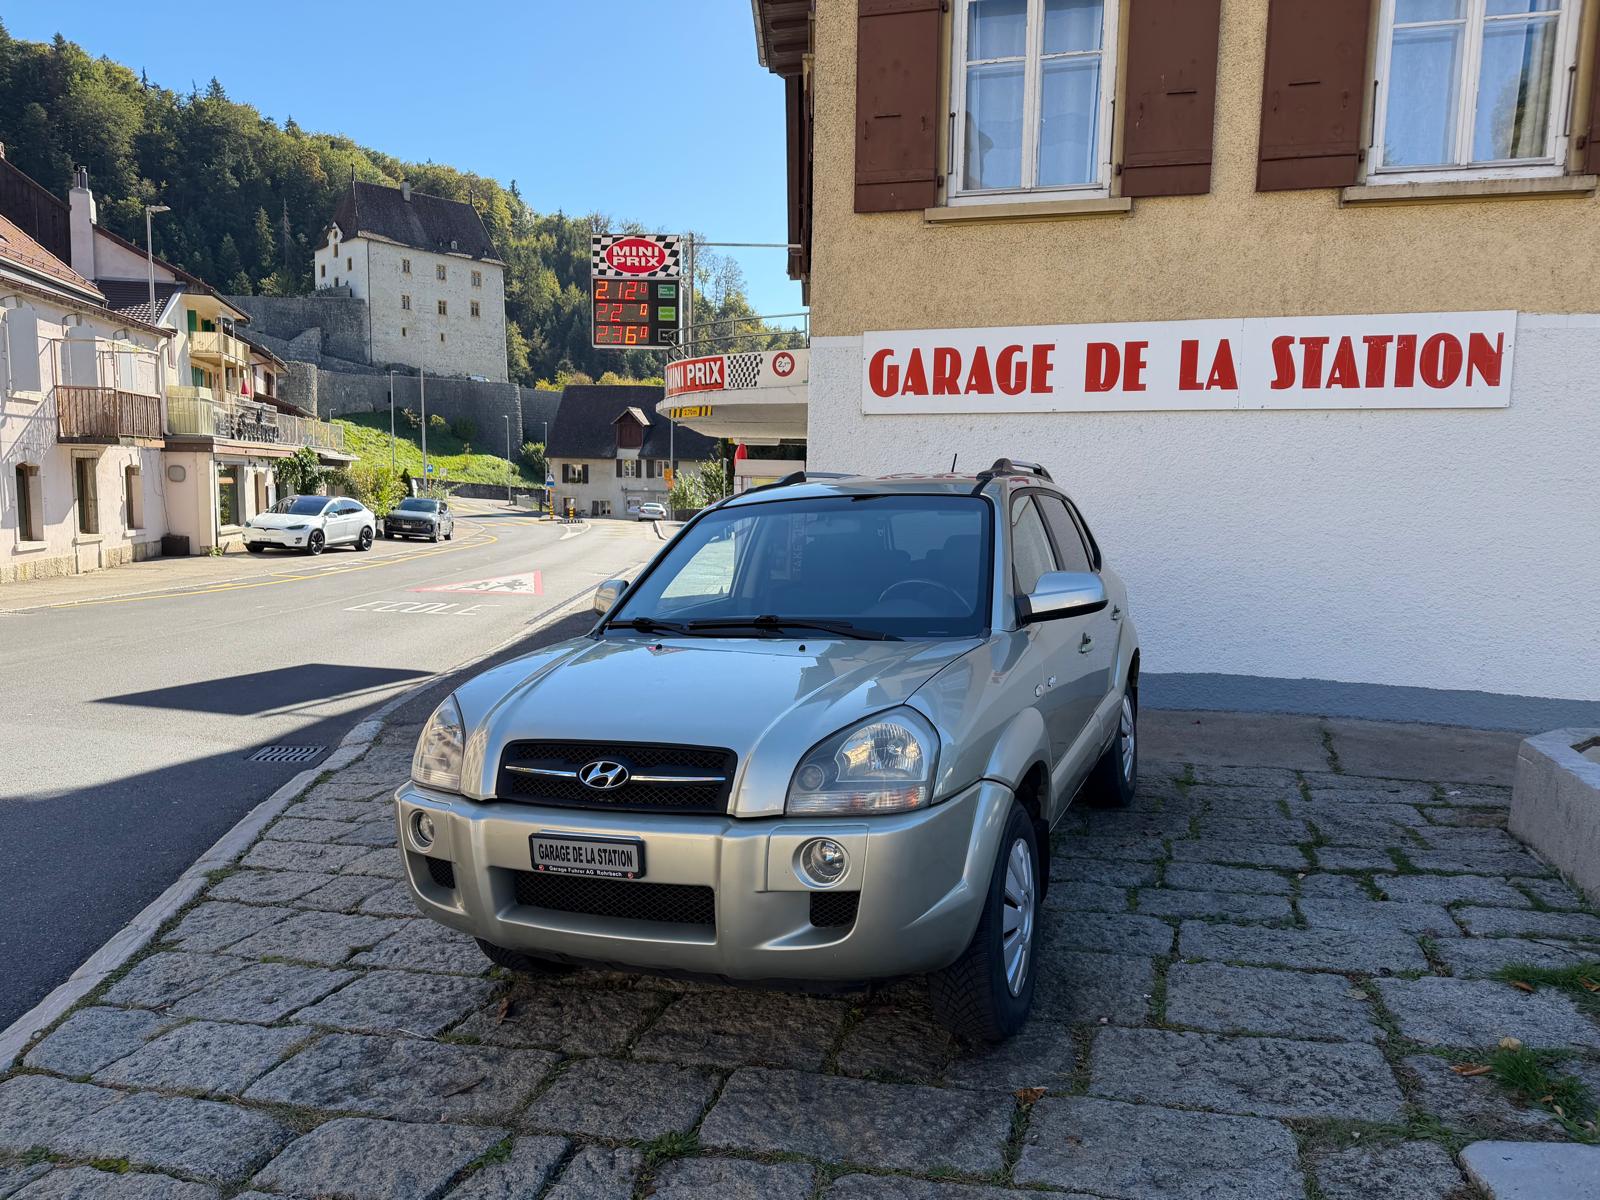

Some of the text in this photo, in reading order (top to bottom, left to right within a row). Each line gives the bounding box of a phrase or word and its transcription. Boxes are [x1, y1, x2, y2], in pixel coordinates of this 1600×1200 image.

[612, 246, 660, 257] MINI
[612, 256, 660, 267] PRIX
[686, 360, 722, 386] PRIX
[869, 332, 1504, 398] GARAGE DE LA STATION
[343, 600, 502, 616] ECOLE
[538, 844, 633, 867] GARAGE DE LA STATION
